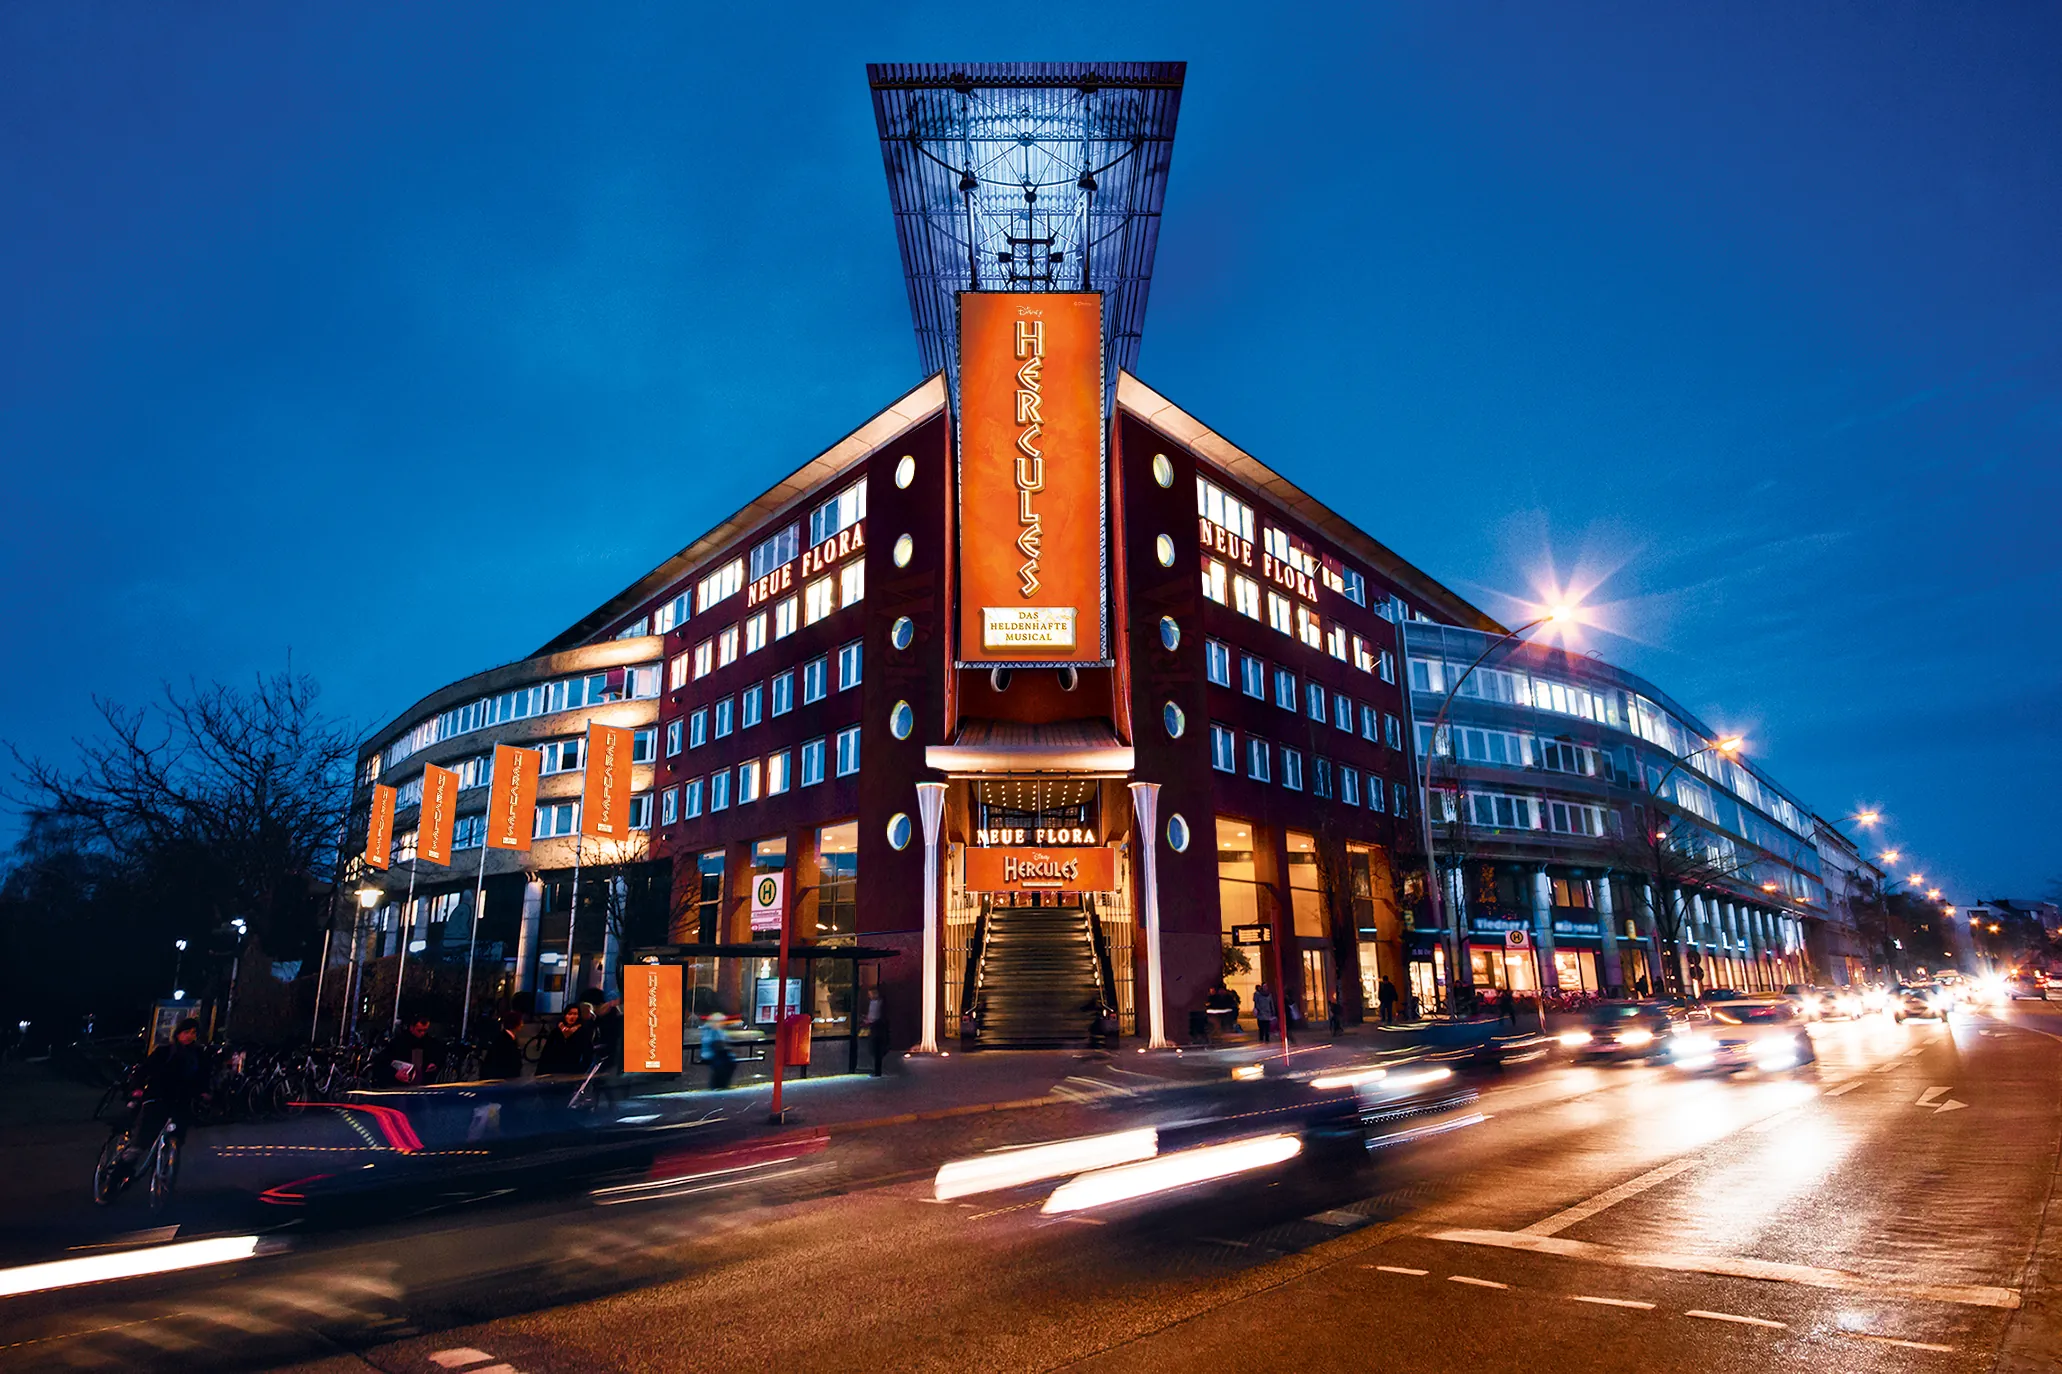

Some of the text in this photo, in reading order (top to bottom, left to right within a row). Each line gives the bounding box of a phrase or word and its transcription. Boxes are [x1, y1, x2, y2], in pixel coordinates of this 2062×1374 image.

[1016, 305, 1043, 318] Disney
[1016, 320, 1046, 598] HERCULES
[747, 522, 866, 608] NEUE FLORA
[1199, 517, 1318, 603] NEUE FLORA
[1018, 611, 1039, 620] DAS
[990, 622, 1068, 630] HELDENHAFTE
[1005, 633, 1053, 641] MUSICAL
[976, 828, 1096, 844] NEUE FLORA
[1004, 856, 1079, 882] HERCULES
